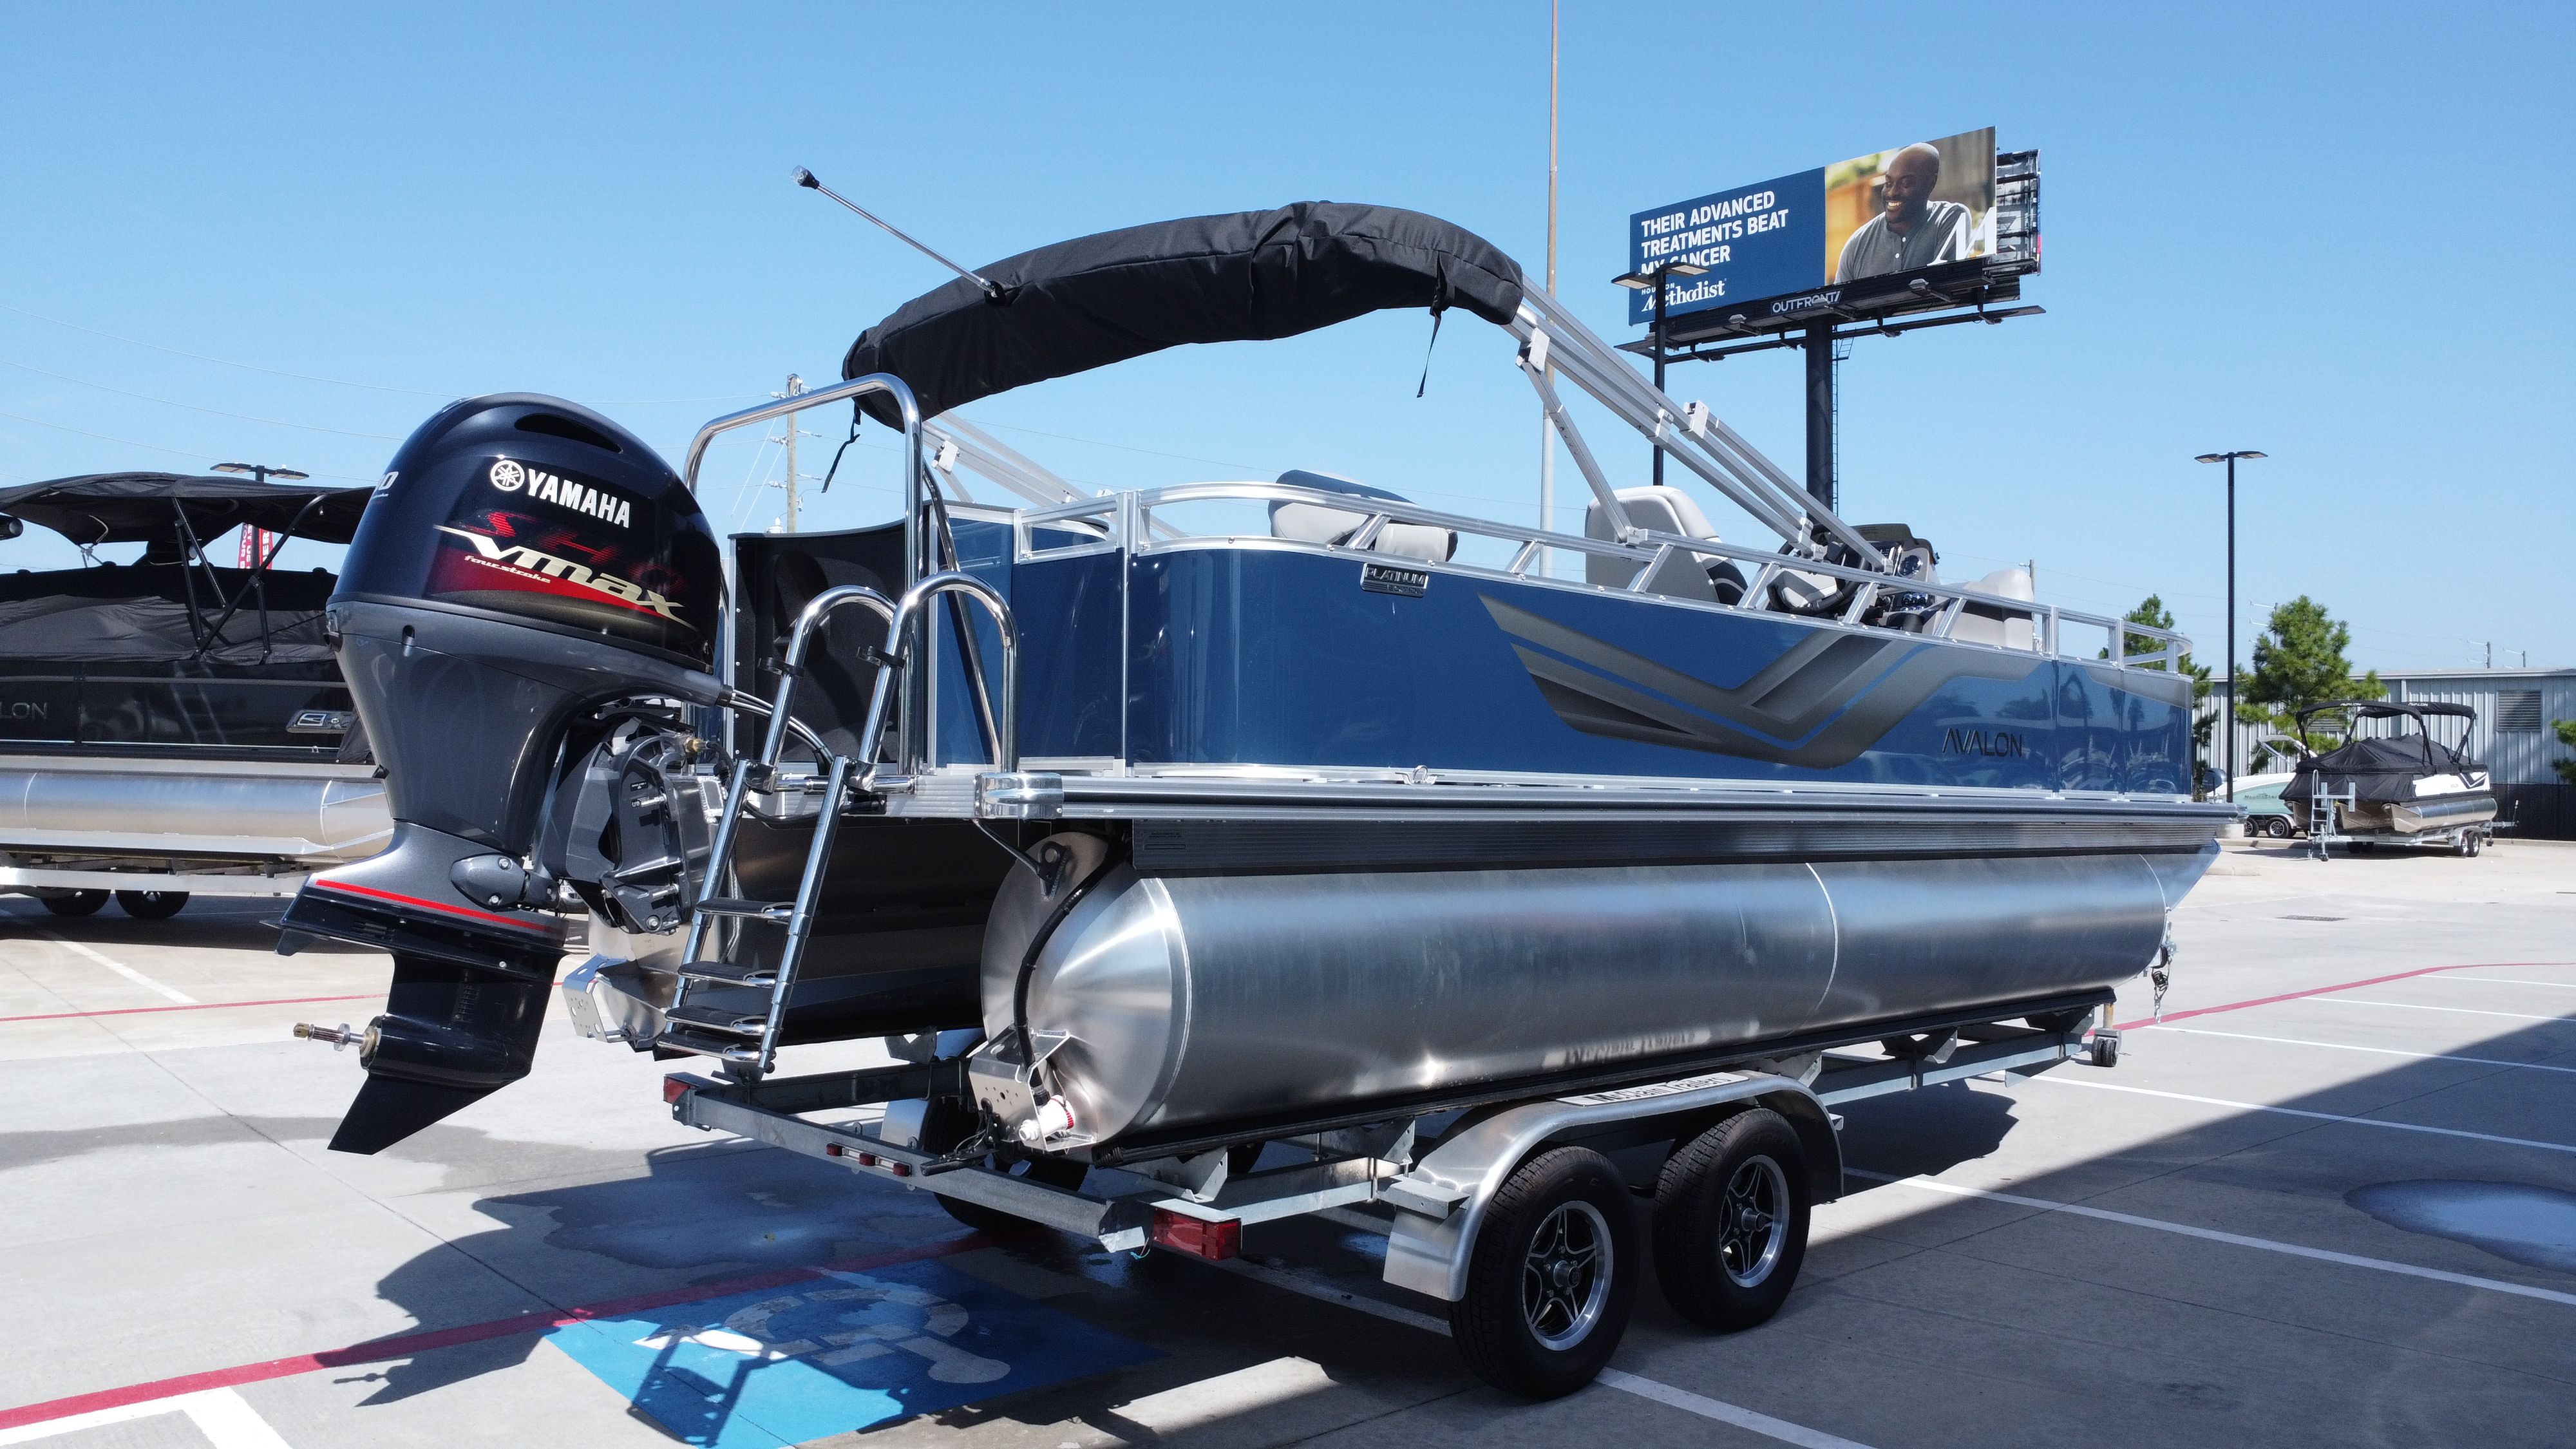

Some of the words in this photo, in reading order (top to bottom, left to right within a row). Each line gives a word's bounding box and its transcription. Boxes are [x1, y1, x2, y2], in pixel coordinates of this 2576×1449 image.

[1642, 213, 1685, 237] THEIR
[1690, 191, 1775, 226] ADVANCED
[1642, 220, 1743, 258] TREATMENTS
[1747, 209, 1788, 235] BEAT
[1642, 283, 1675, 296] HOUON
[527, 468, 630, 528] YAMAHA
[1365, 567, 1425, 584] PLATINUM
[1942, 728, 2022, 757] AVALON
